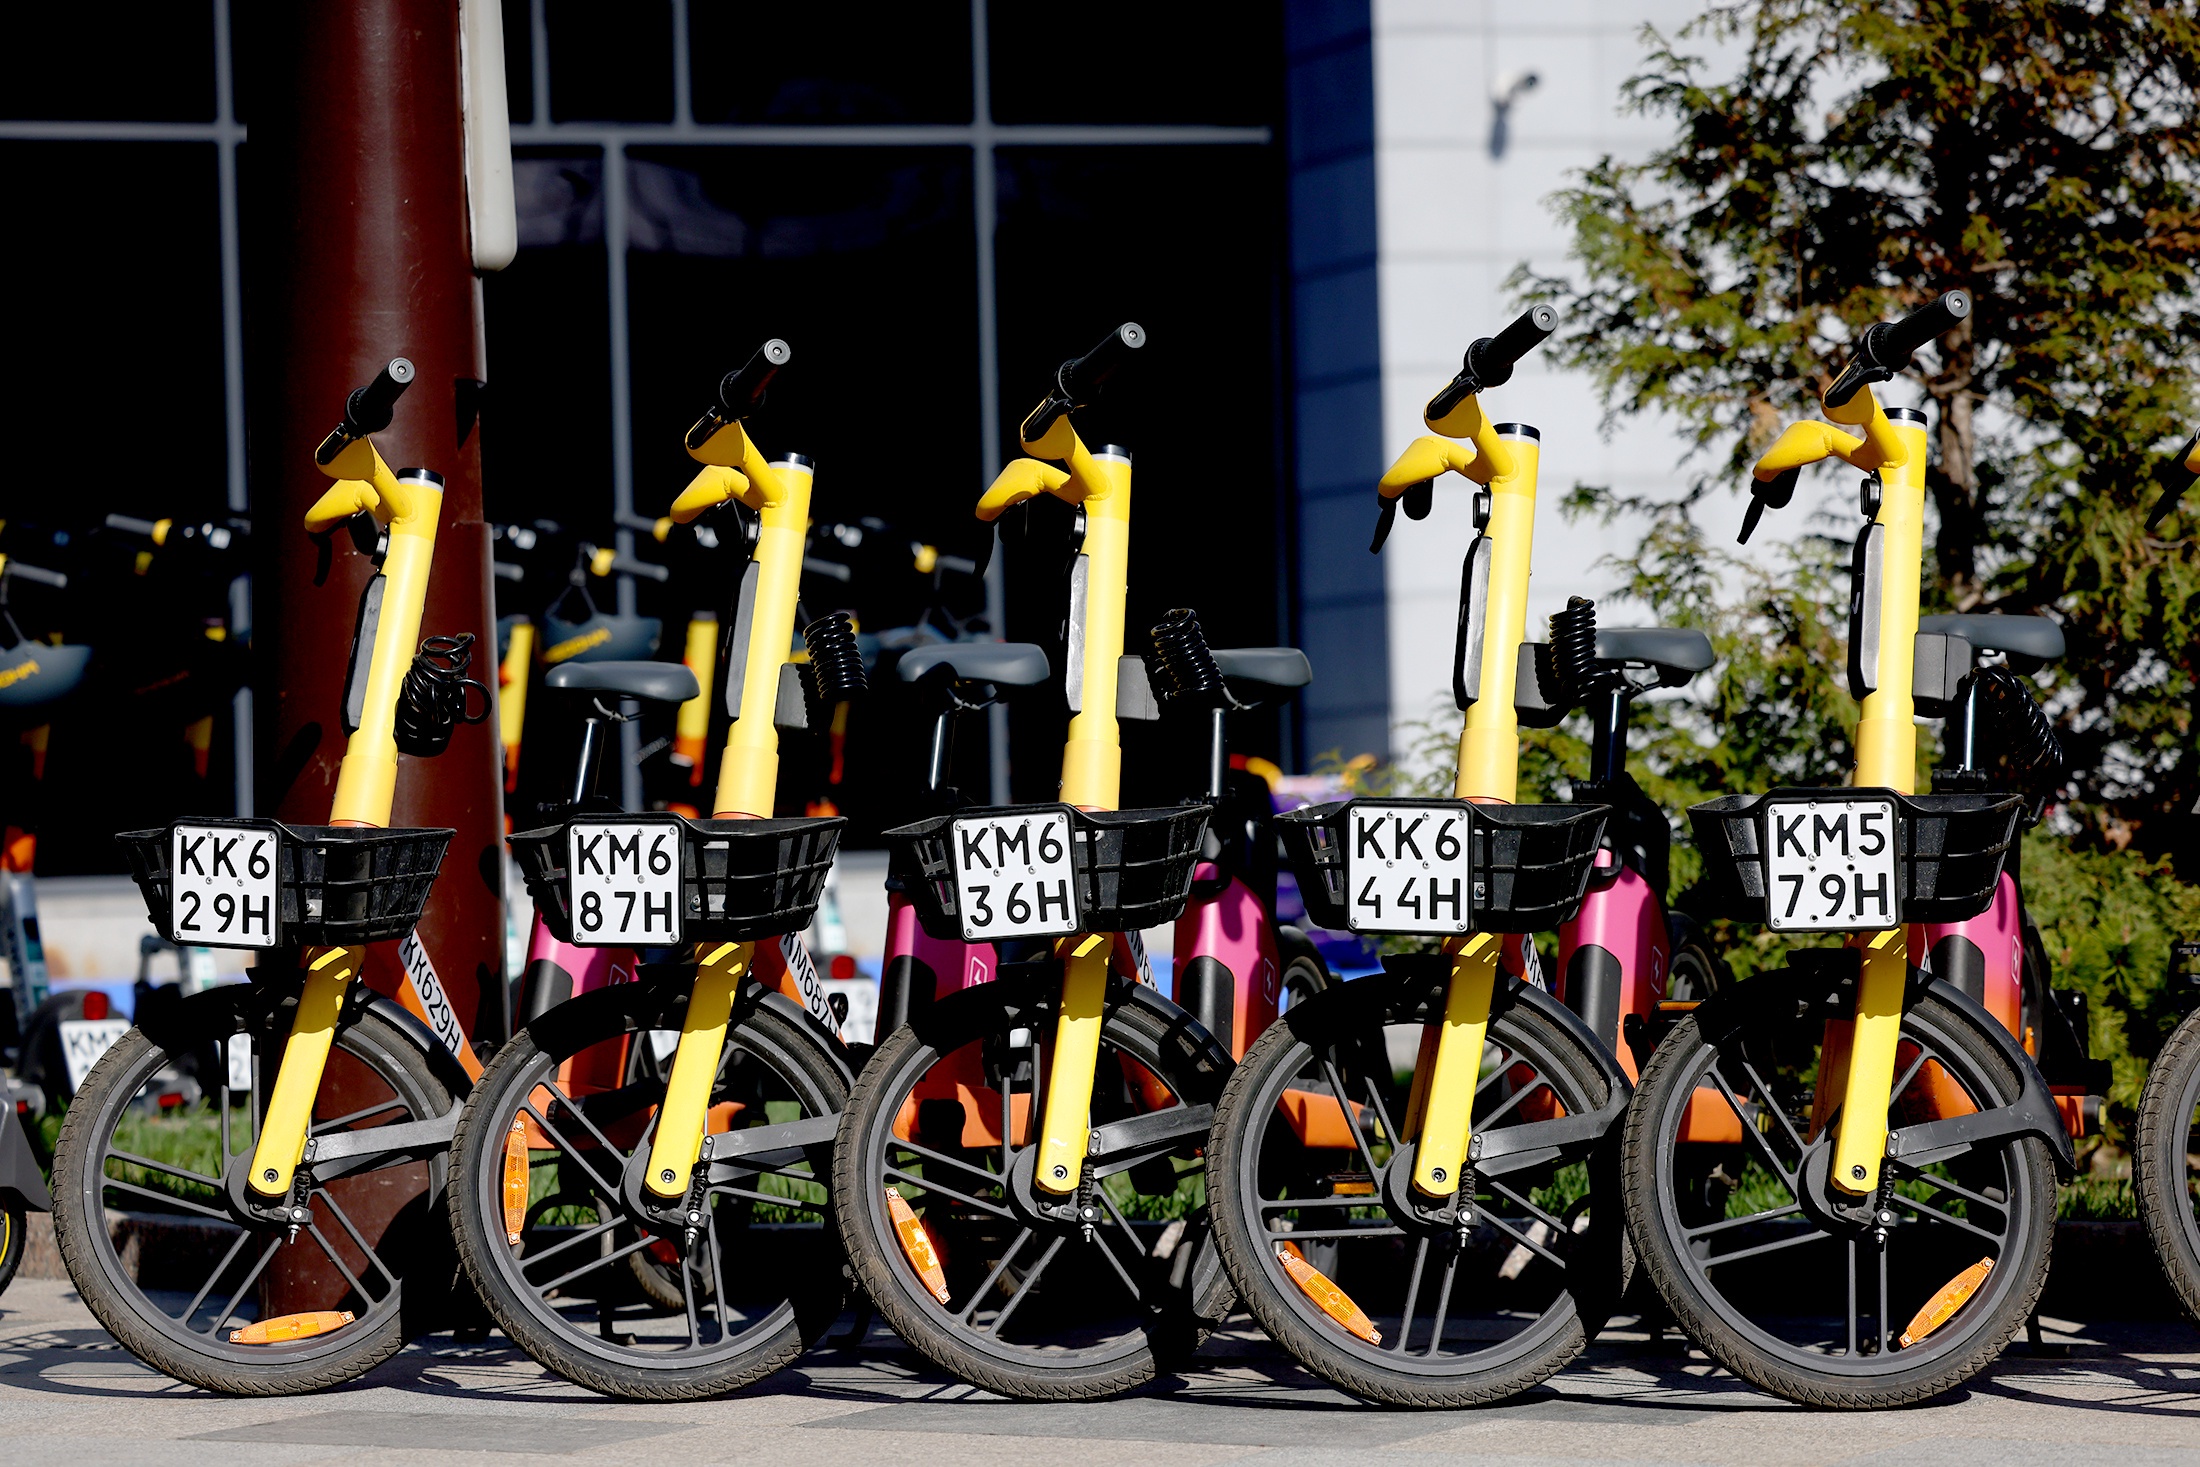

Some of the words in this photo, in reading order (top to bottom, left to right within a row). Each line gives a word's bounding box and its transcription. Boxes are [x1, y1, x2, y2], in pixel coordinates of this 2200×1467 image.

[180, 835, 270, 880] KK6
[577, 833, 672, 876] KM6
[961, 821, 1063, 871] KM6
[1357, 816, 1461, 862] KK6
[1776, 812, 1886, 858] KM5
[180, 890, 270, 936] 29H
[578, 890, 673, 933] 87H
[967, 879, 1070, 928] 36H
[1357, 876, 1461, 921] 44H
[1777, 872, 1888, 918] 79H
[402, 922, 461, 1054] KK629H
